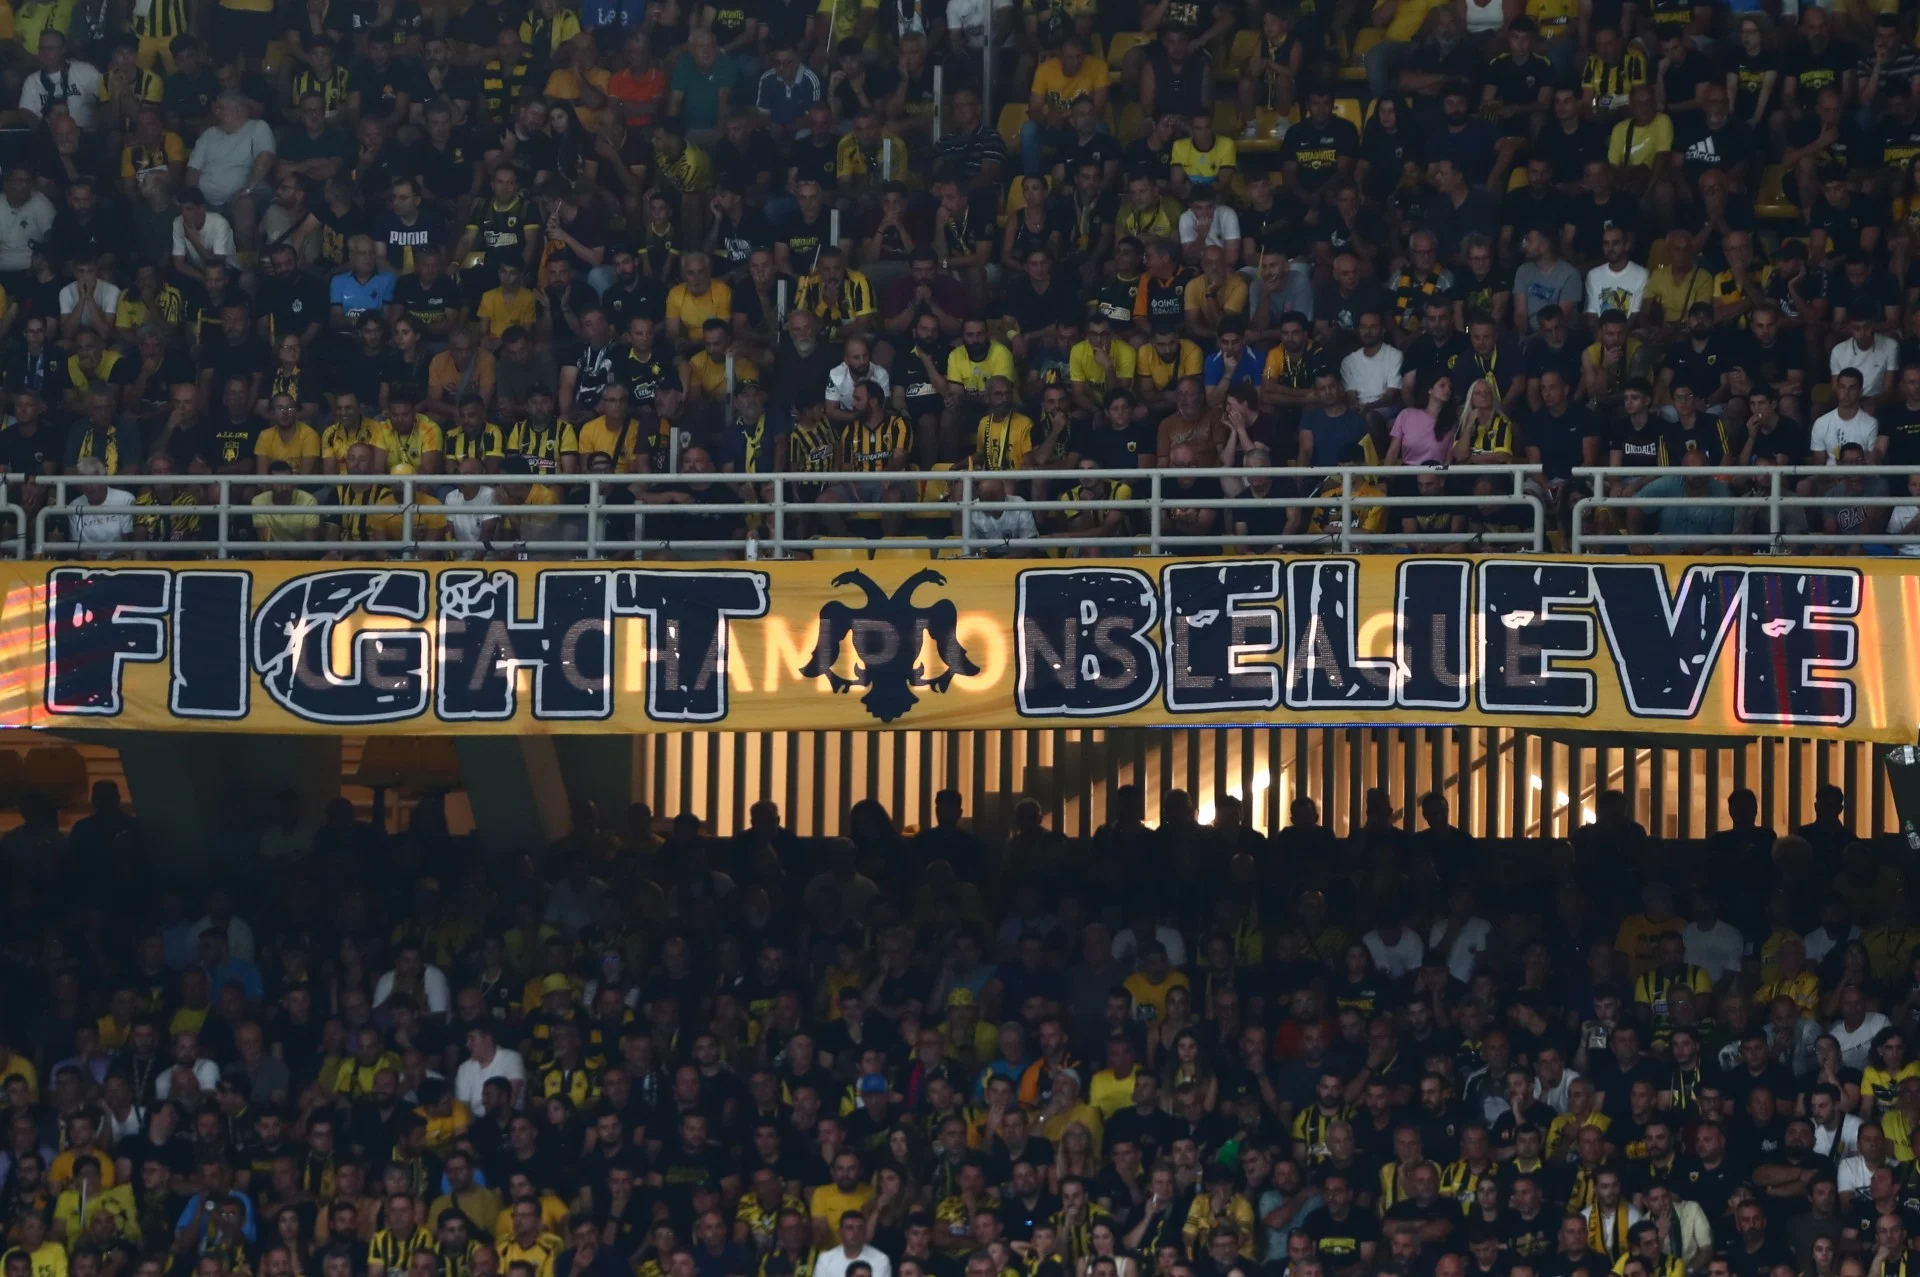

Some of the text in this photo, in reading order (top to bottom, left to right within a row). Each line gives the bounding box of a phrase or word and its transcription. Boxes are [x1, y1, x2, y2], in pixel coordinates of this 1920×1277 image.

[1686, 150, 1721, 162] adidas
[389, 230, 428, 246] PUMA
[46, 557, 1864, 726] FIGHT BELIEVE
[296, 611, 1548, 693] UEFA CHAMPIONS LEAGUE
